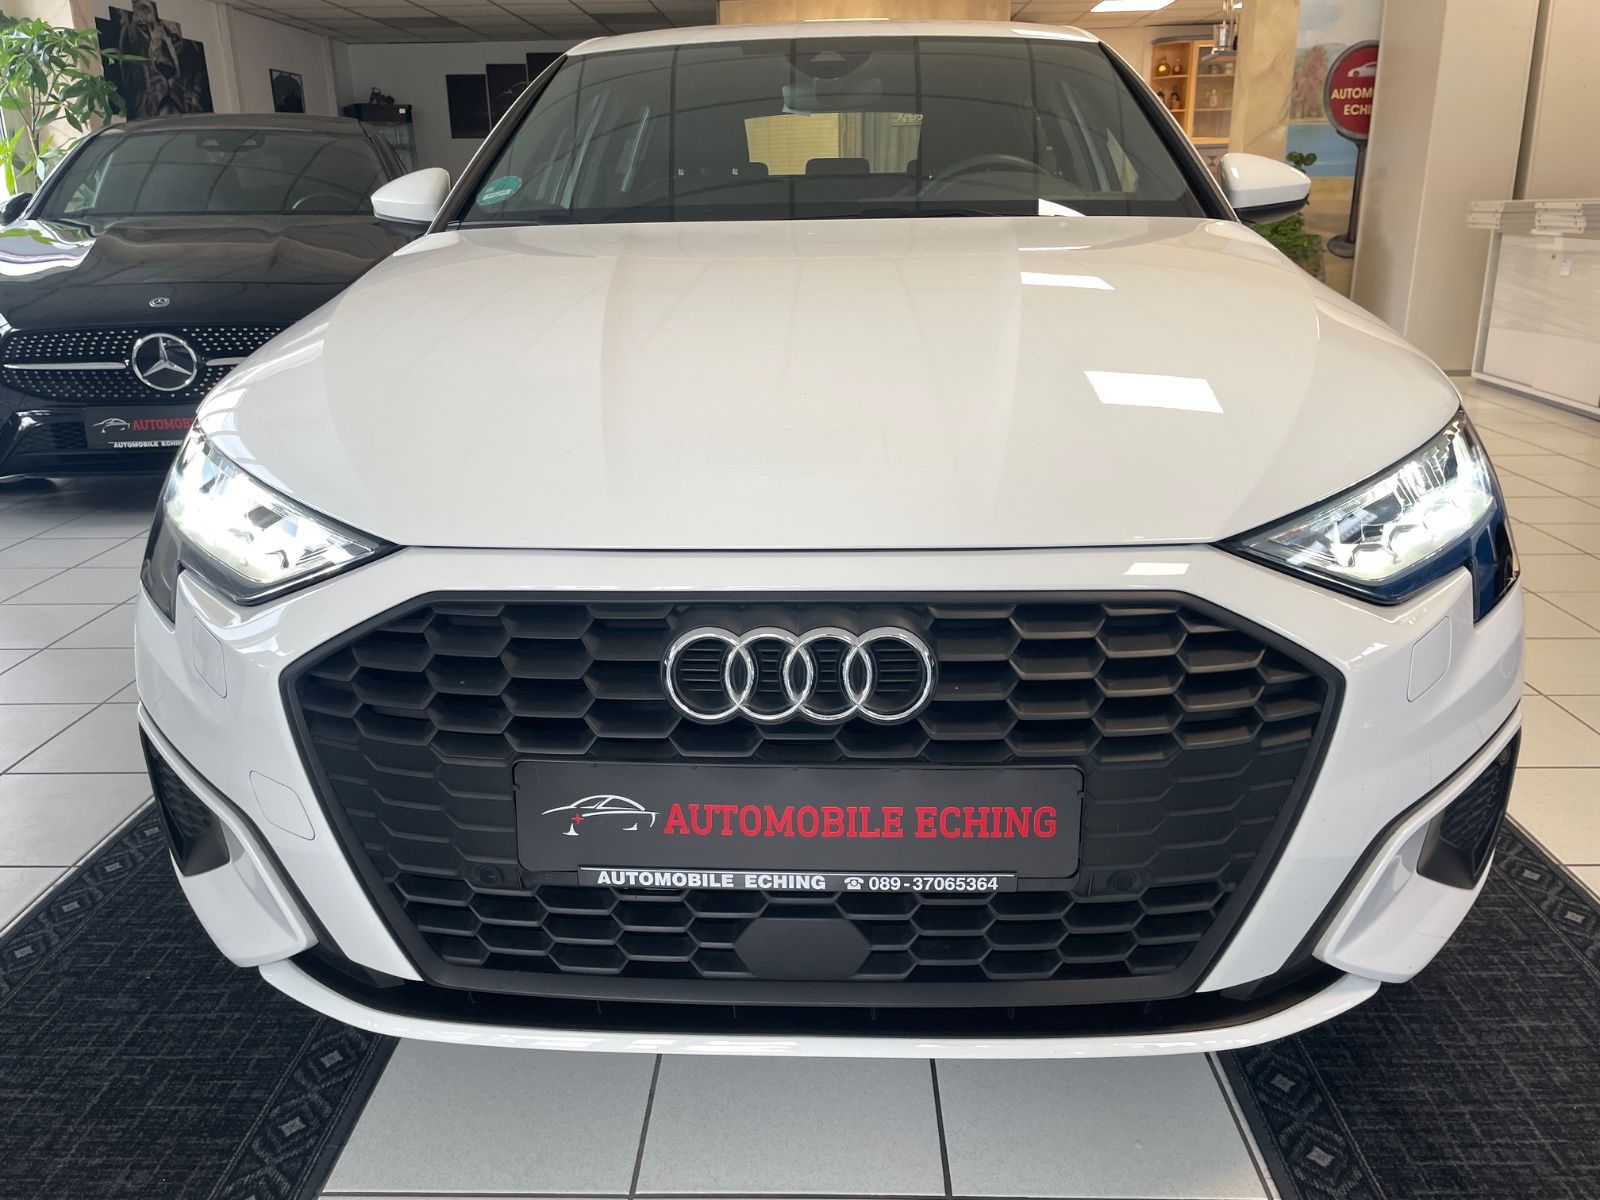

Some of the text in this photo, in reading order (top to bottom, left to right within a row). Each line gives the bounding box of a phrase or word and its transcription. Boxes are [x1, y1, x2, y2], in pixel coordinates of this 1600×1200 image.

[1330, 87, 1374, 100] AUTOM
[1343, 103, 1372, 116] ECHI
[113, 441, 159, 449] AUTOMOBILE
[663, 803, 1057, 839] AUTOMOBILE ECHING
[597, 870, 734, 888] AUTOMOBILE
[744, 874, 826, 890] ECHING
